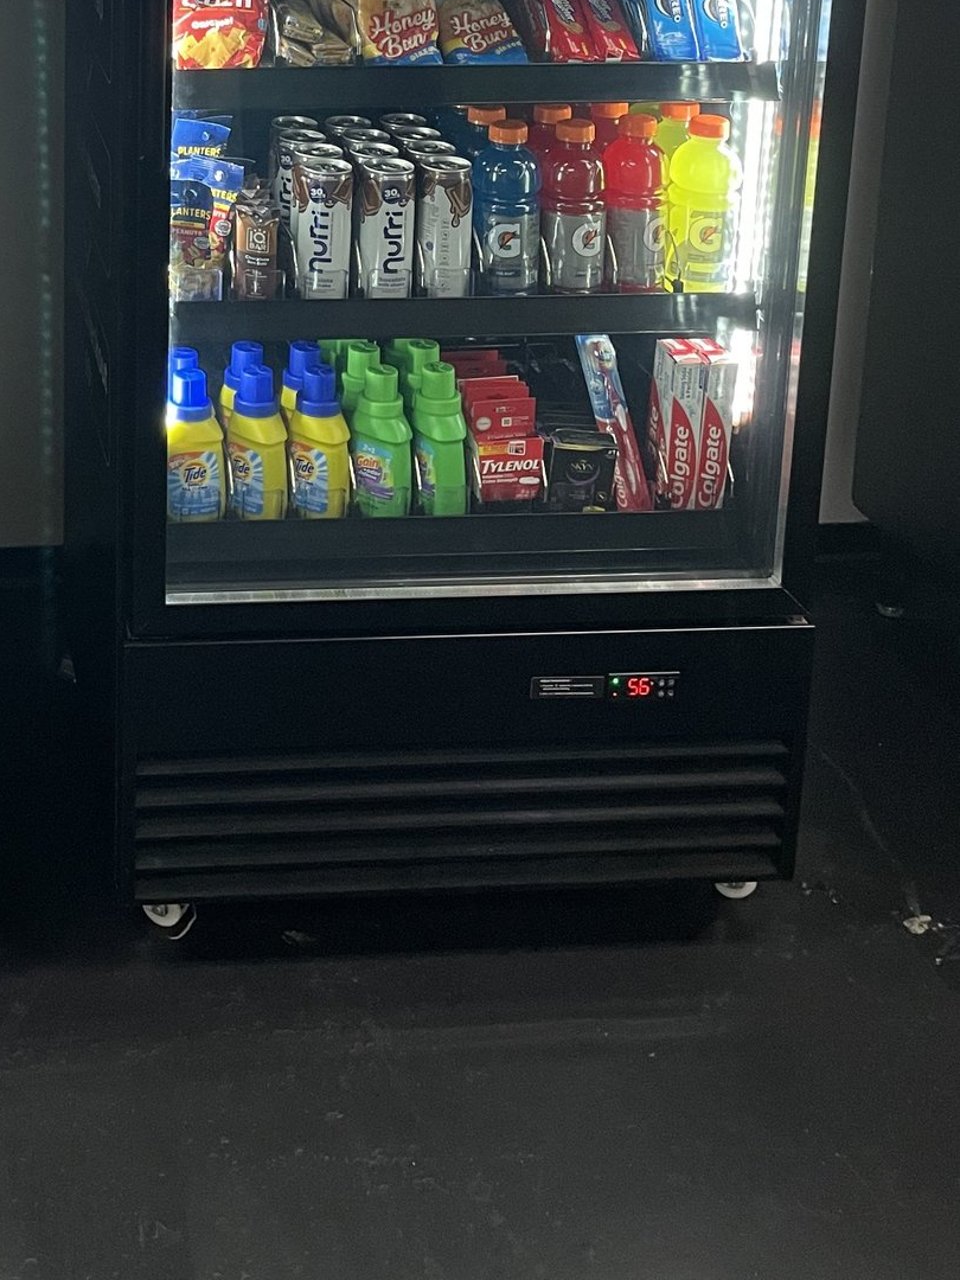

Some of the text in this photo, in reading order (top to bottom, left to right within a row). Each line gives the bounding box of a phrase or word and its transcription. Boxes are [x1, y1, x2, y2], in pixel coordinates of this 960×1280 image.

[371, 8, 436, 38] Honey
[451, 11, 512, 35] Honey
[380, 31, 429, 58] Bun
[464, 28, 508, 52] Bun
[177, 146, 222, 157] PLANTERS
[248, 231, 266, 244] IQ
[309, 209, 333, 274] nurri
[383, 210, 405, 274] nurri
[233, 458, 251, 474] Tide
[295, 458, 315, 474] Tide
[357, 455, 380, 468] Gain
[481, 459, 540, 474] TYLENOL
[670, 425, 690, 508] Colgate
[698, 425, 722, 508] Colgate
[183, 467, 207, 483] Tide
[628, 677, 650, 696] 56
